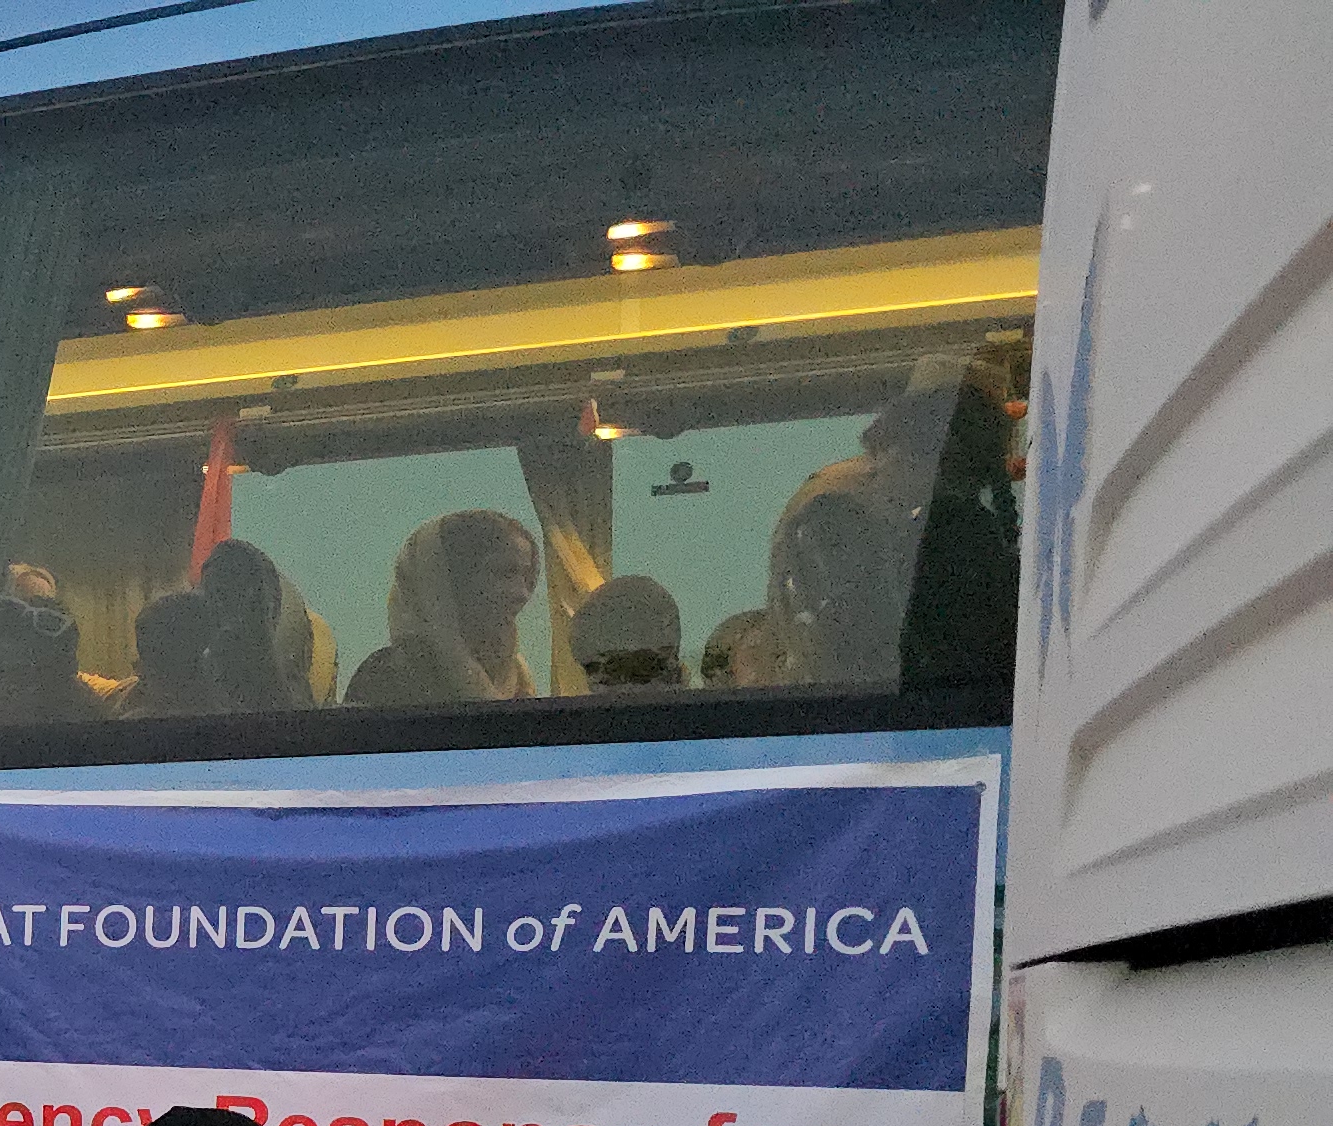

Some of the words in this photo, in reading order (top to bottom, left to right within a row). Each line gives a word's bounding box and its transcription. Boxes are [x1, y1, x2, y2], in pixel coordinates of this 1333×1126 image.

[60, 904, 483, 952] FOUNDATION
[506, 903, 582, 952] of
[592, 906, 929, 955] AMERICA
